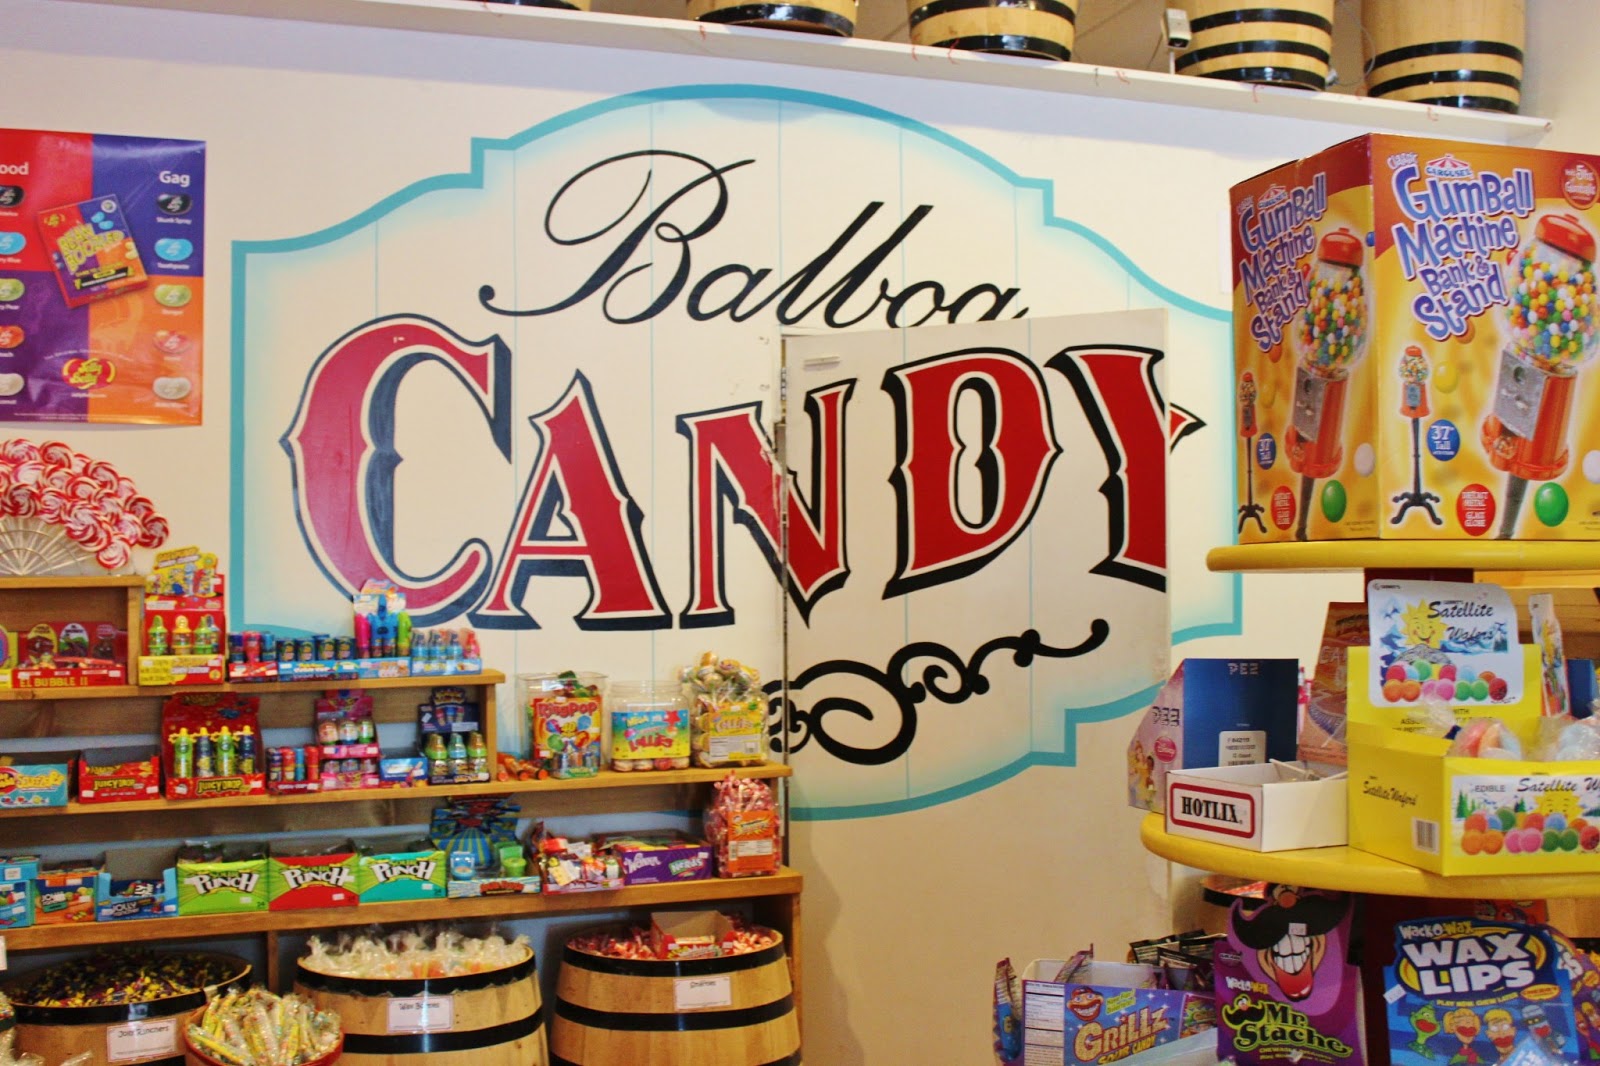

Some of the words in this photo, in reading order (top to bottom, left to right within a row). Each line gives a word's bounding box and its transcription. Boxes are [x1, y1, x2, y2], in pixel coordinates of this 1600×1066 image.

[159, 170, 190, 187] Gag
[1395, 167, 1532, 222] GumBall
[1240, 172, 1326, 253] GumBall
[480, 149, 1029, 329] Balboa
[1395, 216, 1516, 278] Machine
[1240, 226, 1314, 304] Machine
[1420, 259, 1475, 296] Bank
[1476, 255, 1490, 277] &
[1251, 270, 1308, 350] Stand
[1254, 275, 1287, 312] Bank
[1414, 264, 1507, 337] Stand
[1434, 440, 1451, 450] Tall
[279, 312, 1207, 630] CANDY
[1426, 601, 1494, 619] Satellite
[1227, 662, 1259, 675] PEZ
[1517, 777, 1577, 792] Satellite
[1181, 796, 1238, 824] HOTLIX
[1402, 933, 1530, 967] WAX
[1419, 960, 1534, 996] LIPS
[1236, 1024, 1347, 1054] Stache
